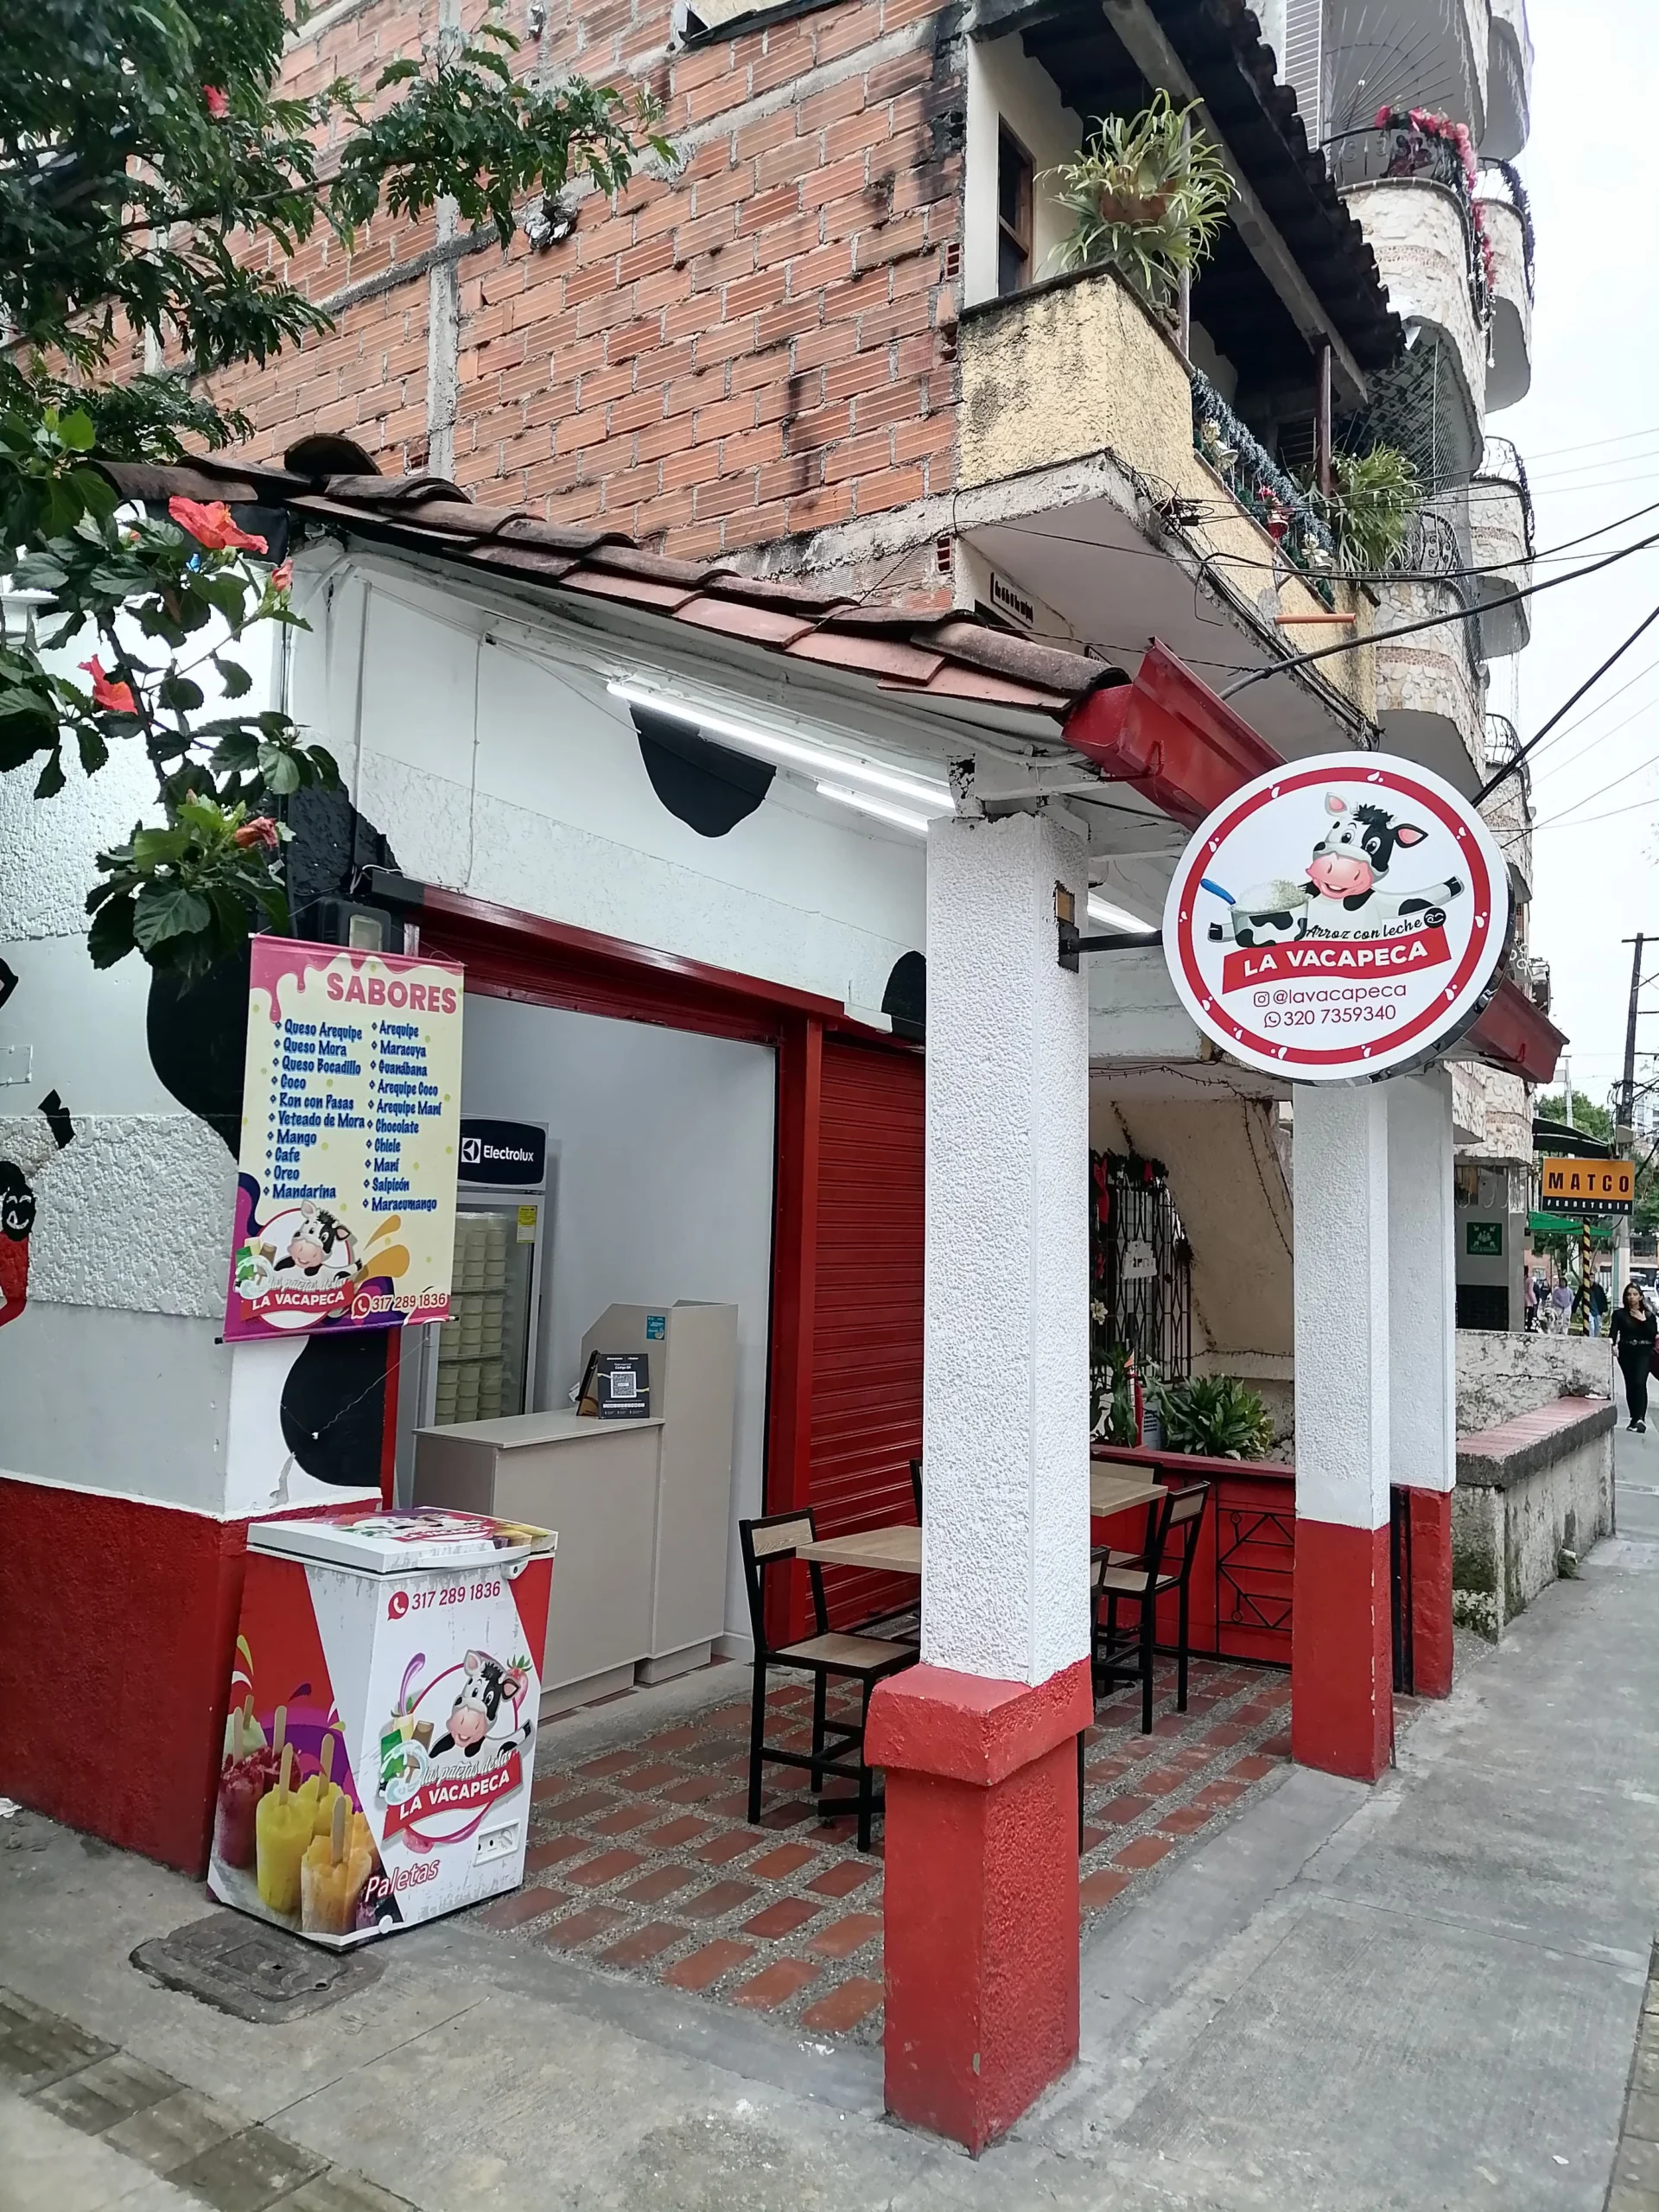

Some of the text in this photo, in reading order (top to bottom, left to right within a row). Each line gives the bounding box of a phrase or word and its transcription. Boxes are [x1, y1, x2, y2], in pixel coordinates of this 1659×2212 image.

[1306, 918, 1422, 940] Arroz con leche
[1243, 940, 1428, 977] LA VACAPECA
[327, 972, 457, 1014] SABORES
[1273, 984, 1407, 1005] @lavacapeca
[1283, 1004, 1396, 1027] 320 7359340
[284, 1019, 363, 1043] Queso Arequipe
[379, 1020, 419, 1040] Arequipe
[283, 1037, 347, 1057] Queso Mora
[380, 1039, 426, 1059] Maracuya
[282, 1055, 361, 1076] Queso Bocadillo
[378, 1058, 428, 1077] Guanábana
[280, 1073, 307, 1090] Coco
[378, 1079, 438, 1097] Arequipe Coco
[279, 1092, 354, 1110] Ron con Pasas
[376, 1098, 442, 1117] Arequipe Maní
[278, 1110, 365, 1128] Veteado de Mora
[375, 1119, 420, 1135] Chocolate
[276, 1128, 317, 1147] Mango
[374, 1138, 401, 1153] Chicle
[275, 1147, 300, 1163] Cafe
[484, 1145, 534, 1162] Electrolux
[274, 1166, 300, 1180] Oreo
[373, 1158, 399, 1173] Maní
[272, 1184, 336, 1199] Mandarina
[372, 1177, 410, 1194] Salpicón
[1548, 1172, 1630, 1192] MATCO
[372, 1197, 438, 1212] Maracumango
[251, 1291, 346, 1310] LA VACAPECA
[372, 1294, 447, 1311] 317 289 1836
[411, 1580, 501, 1610] 317 289 1836
[399, 1770, 510, 1821] LA VACAPECA
[365, 1859, 441, 1903] Paletas
